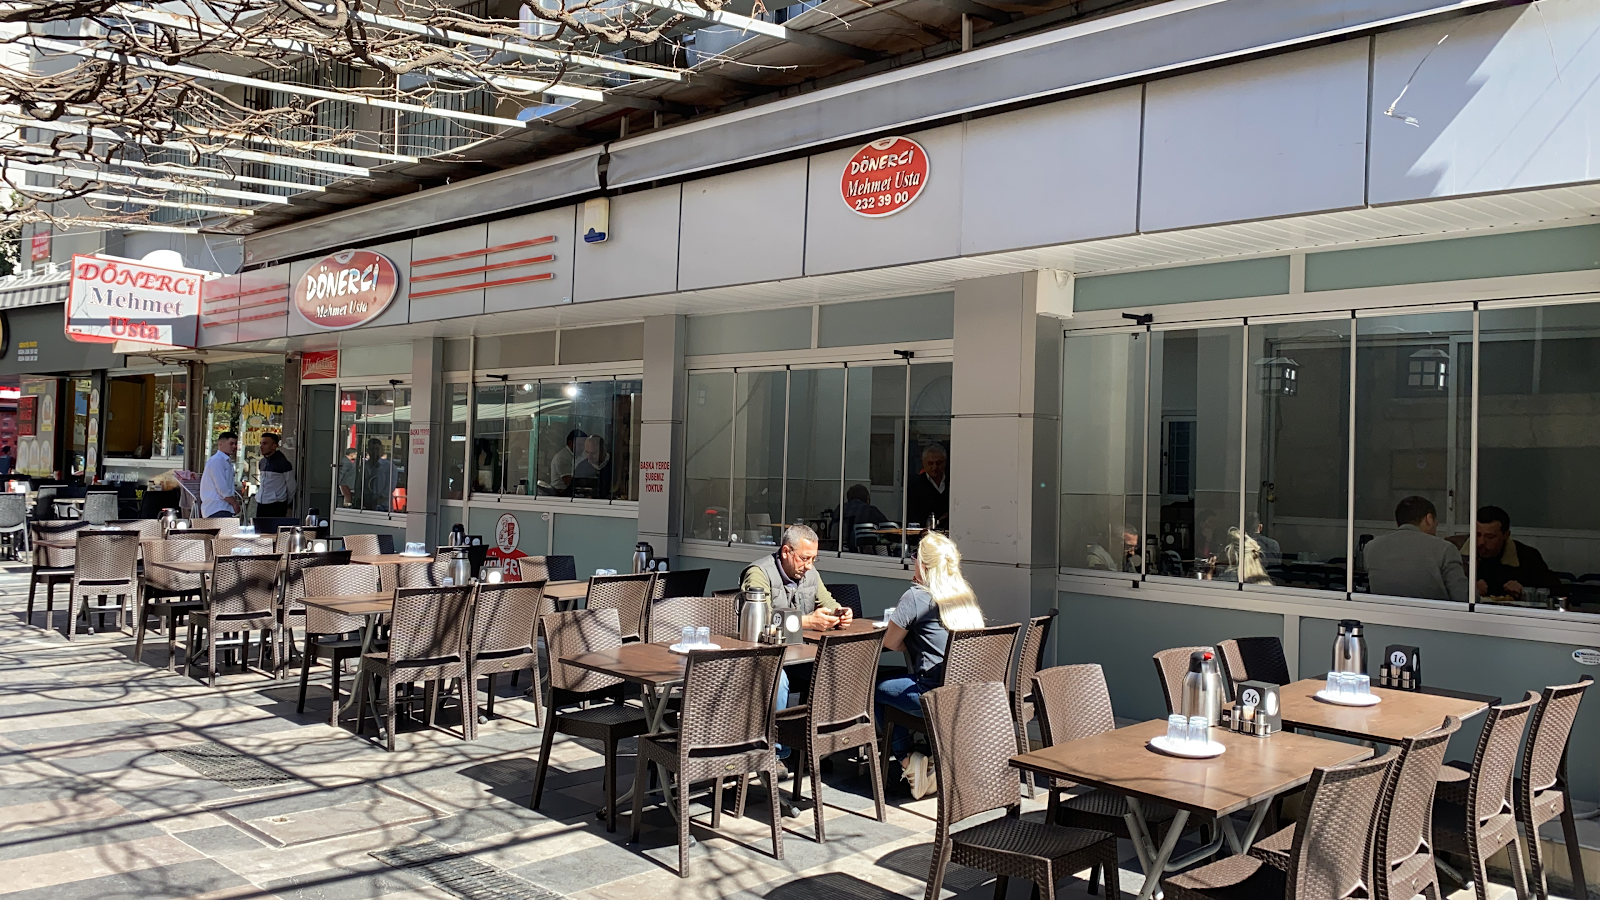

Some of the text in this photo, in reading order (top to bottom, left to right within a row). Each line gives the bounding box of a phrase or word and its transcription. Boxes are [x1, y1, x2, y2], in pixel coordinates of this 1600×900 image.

[846, 170, 921, 198] Mehmet Usta
[855, 191, 909, 211] 232 39 00
[88, 286, 184, 317] Mehmet
[315, 301, 368, 319] Mehmet Usta
[109, 315, 161, 341] Usta
[640, 461, 670, 471] BAŞKA YERDE
[645, 484, 664, 492] YOKTUR
[1393, 654, 1405, 664] 16
[1244, 692, 1258, 704] 26
